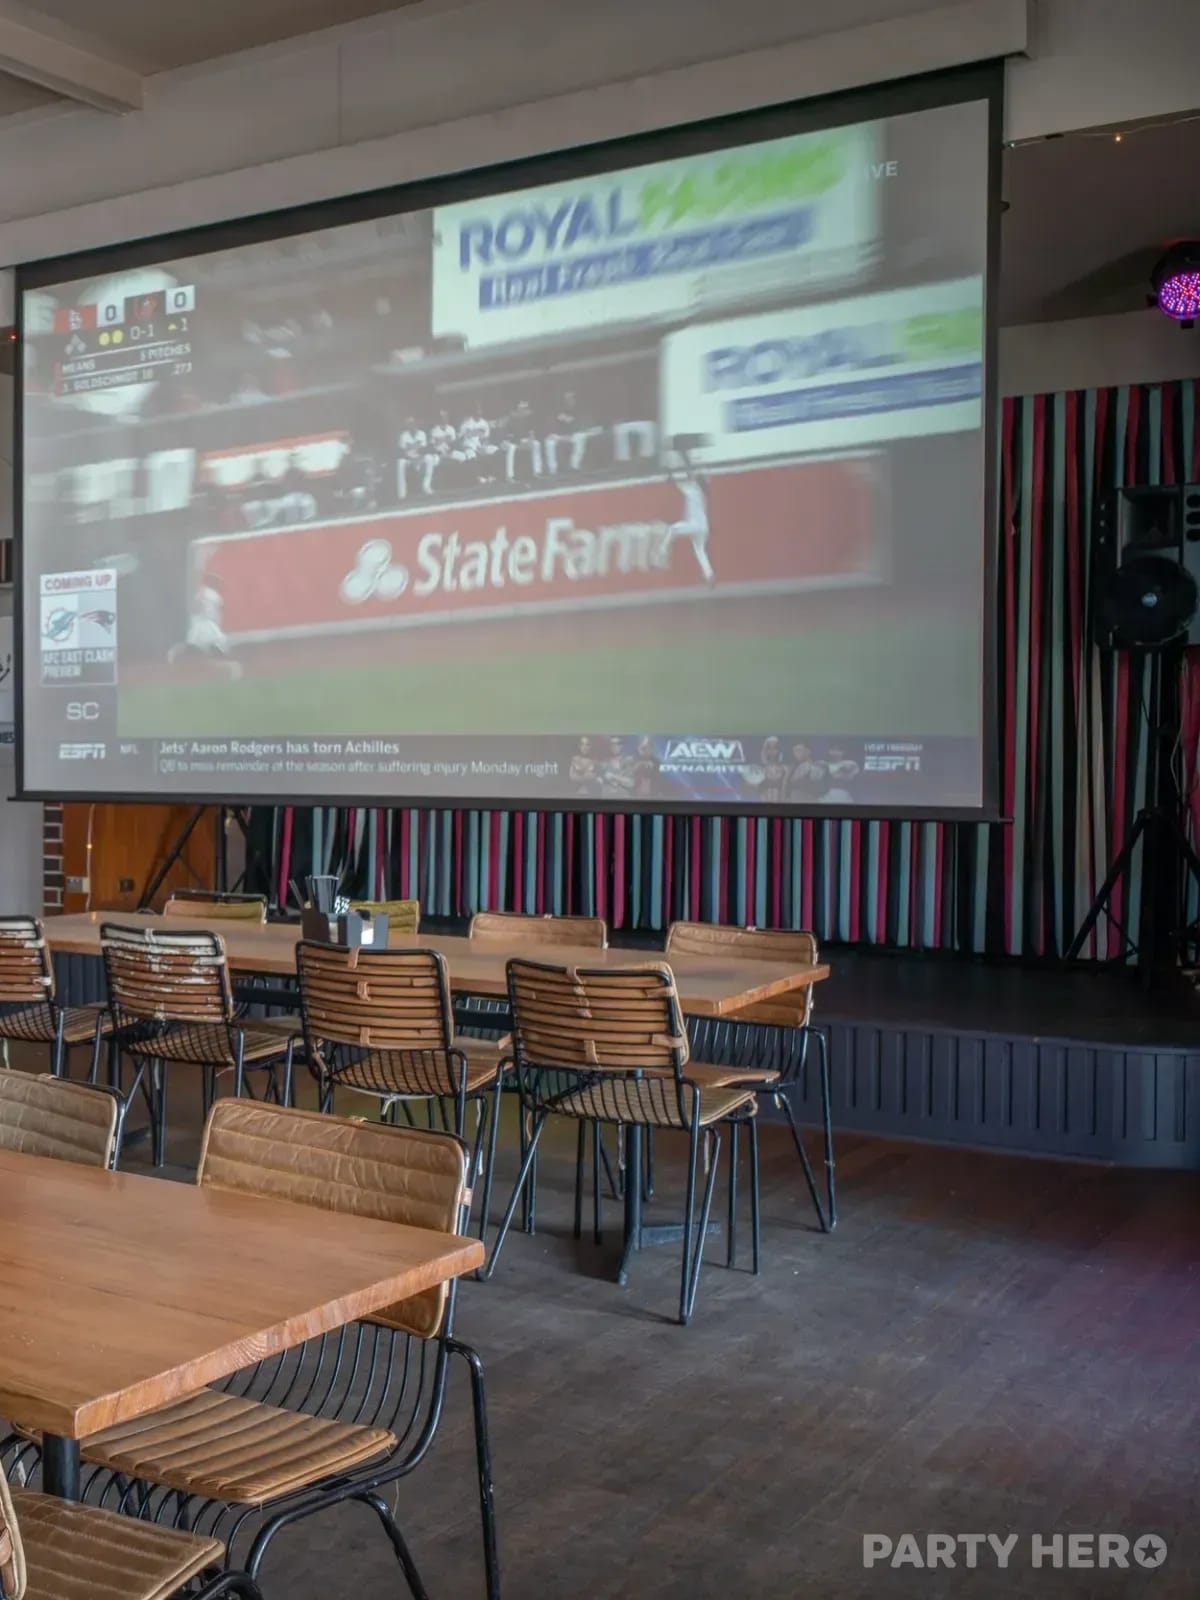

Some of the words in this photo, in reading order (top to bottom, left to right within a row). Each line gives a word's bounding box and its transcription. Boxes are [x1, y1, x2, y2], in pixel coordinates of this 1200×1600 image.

[460, 186, 642, 272] ROYAL
[105, 304, 116, 321] 0
[174, 292, 186, 308] 0
[44, 575, 92, 591] COMING
[95, 574, 112, 587] UP
[66, 702, 100, 720] SC
[59, 743, 106, 760] ESPN
[191, 742, 228, 754] Aaron
[231, 741, 282, 758] Rodgers
[285, 741, 309, 754] has
[313, 742, 342, 754] torn
[345, 741, 400, 754] Achilles
[670, 742, 737, 759] AEW
[377, 760, 431, 776] suffering
[471, 761, 522, 776] Monday
[524, 761, 558, 777] night
[864, 756, 921, 771] ESPN
